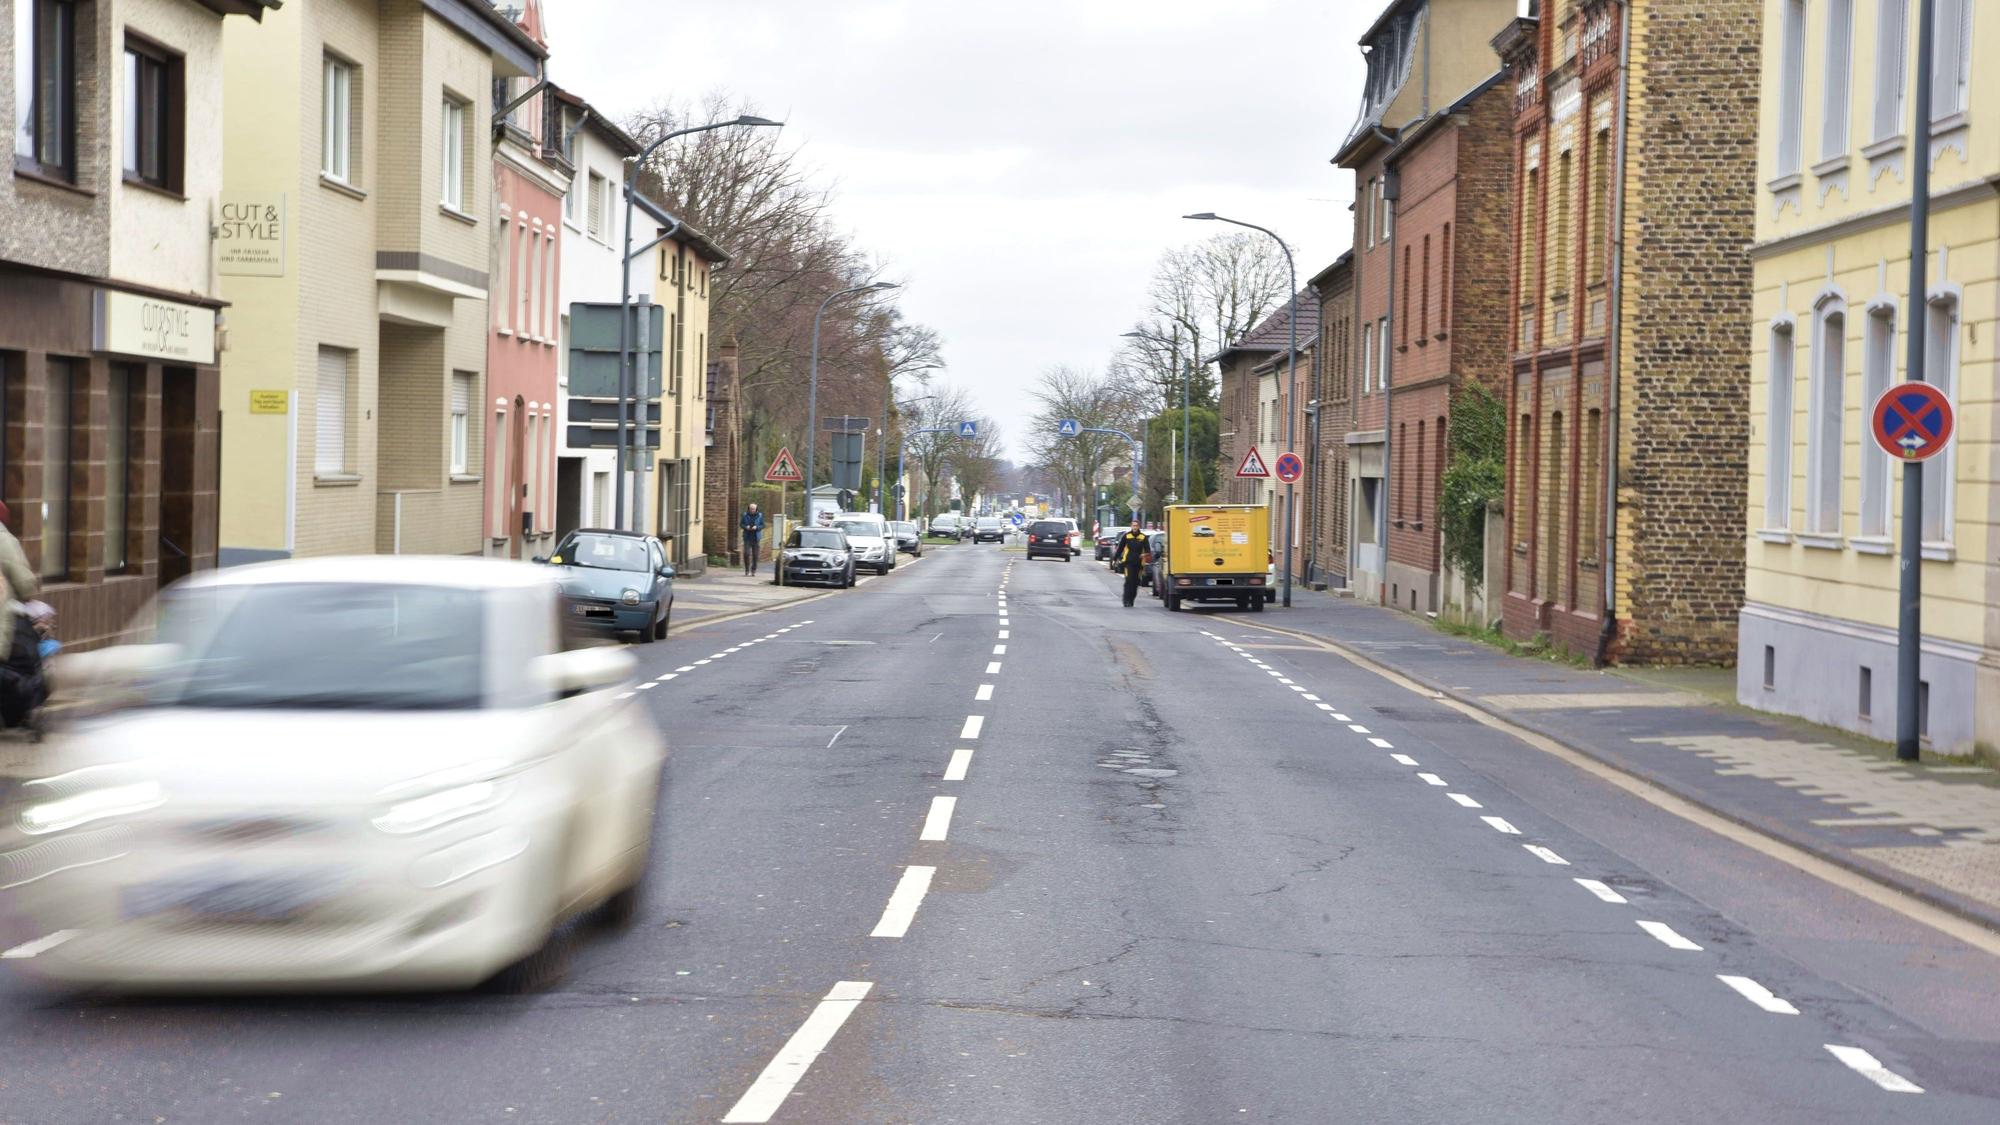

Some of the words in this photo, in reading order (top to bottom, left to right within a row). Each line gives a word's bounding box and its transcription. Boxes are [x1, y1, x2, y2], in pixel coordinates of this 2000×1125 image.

[222, 203, 262, 221] CUT
[265, 204, 279, 221] &
[222, 222, 280, 240] STYLE
